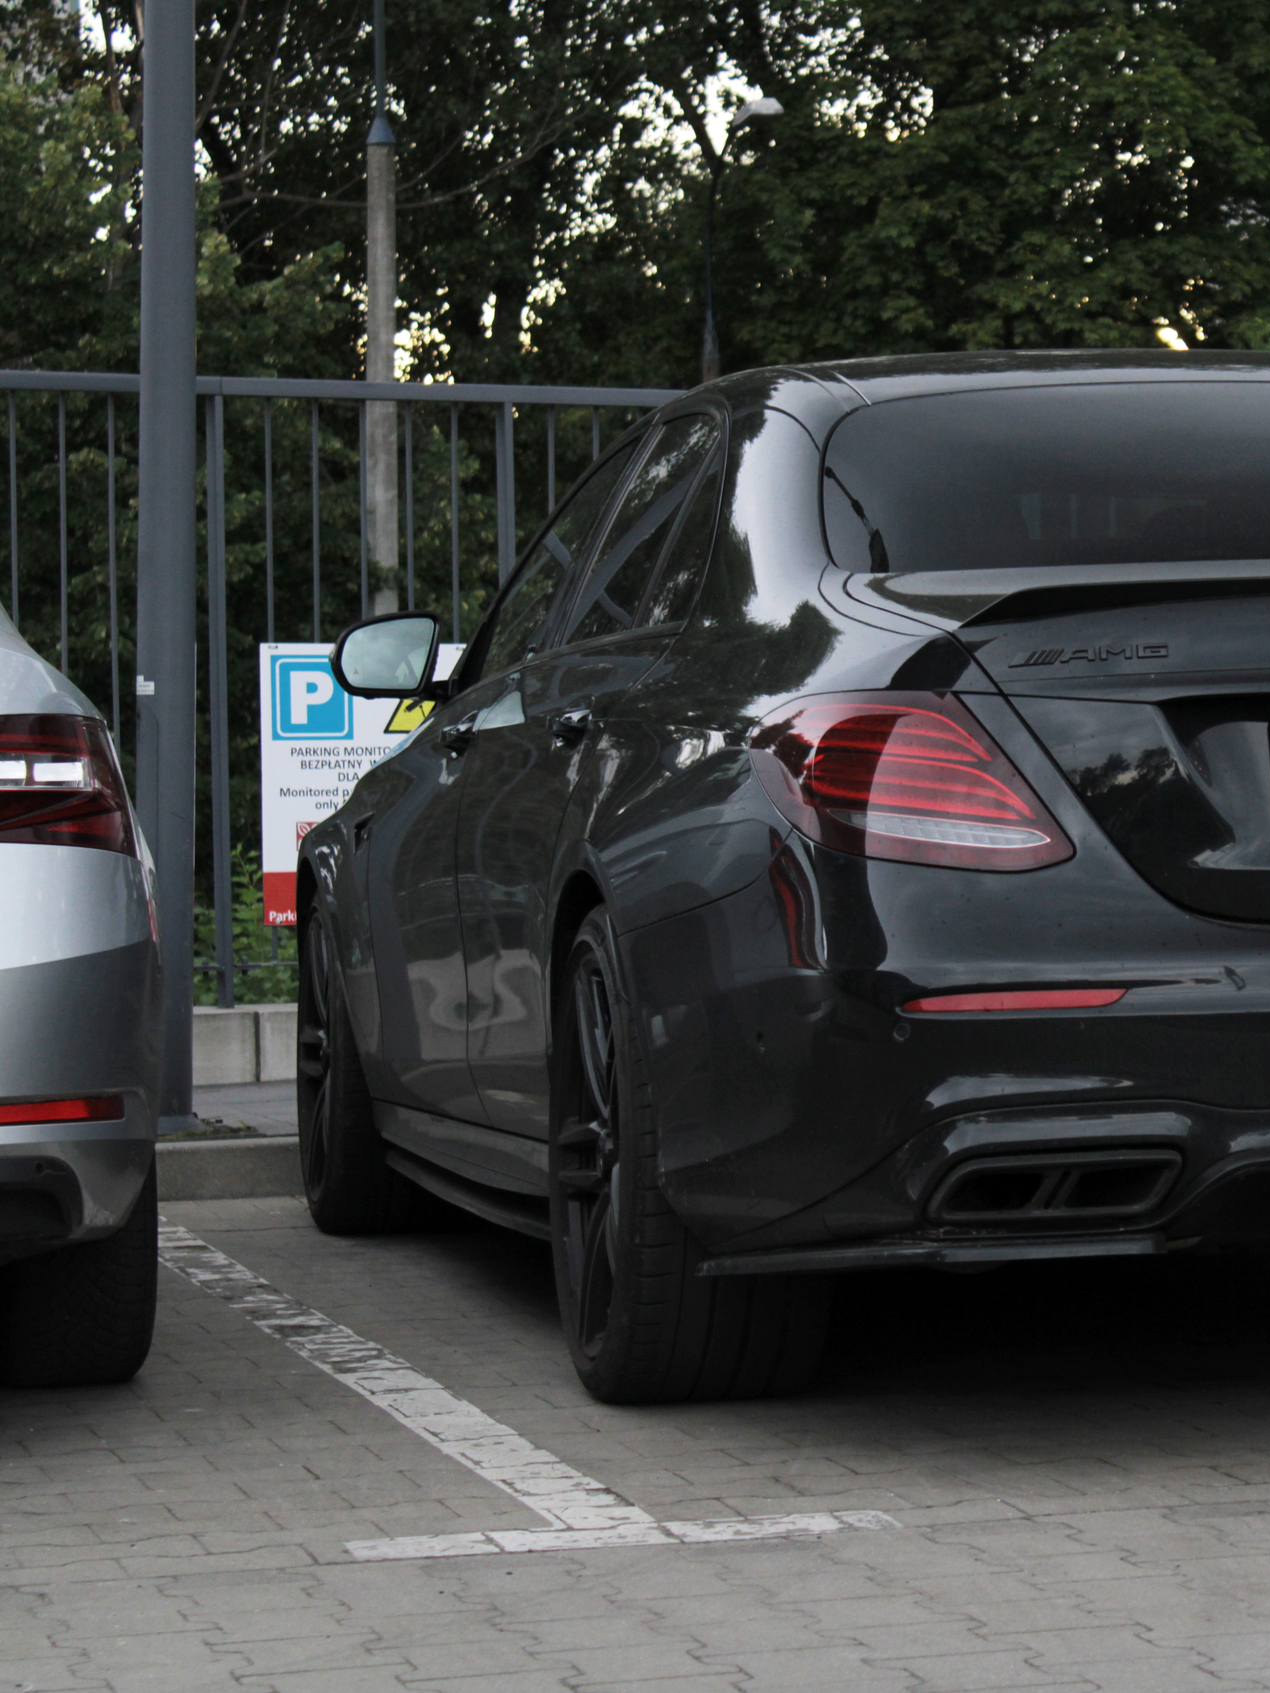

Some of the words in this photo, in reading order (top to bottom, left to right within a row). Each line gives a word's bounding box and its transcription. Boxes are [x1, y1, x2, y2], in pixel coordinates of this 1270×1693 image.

[290, 671, 334, 724] P
[291, 747, 340, 757] PARKING
[301, 760, 363, 770] BEZPŁATNY
[338, 772, 360, 782] DLA
[280, 786, 339, 798] Monitored
[315, 800, 339, 814] only
